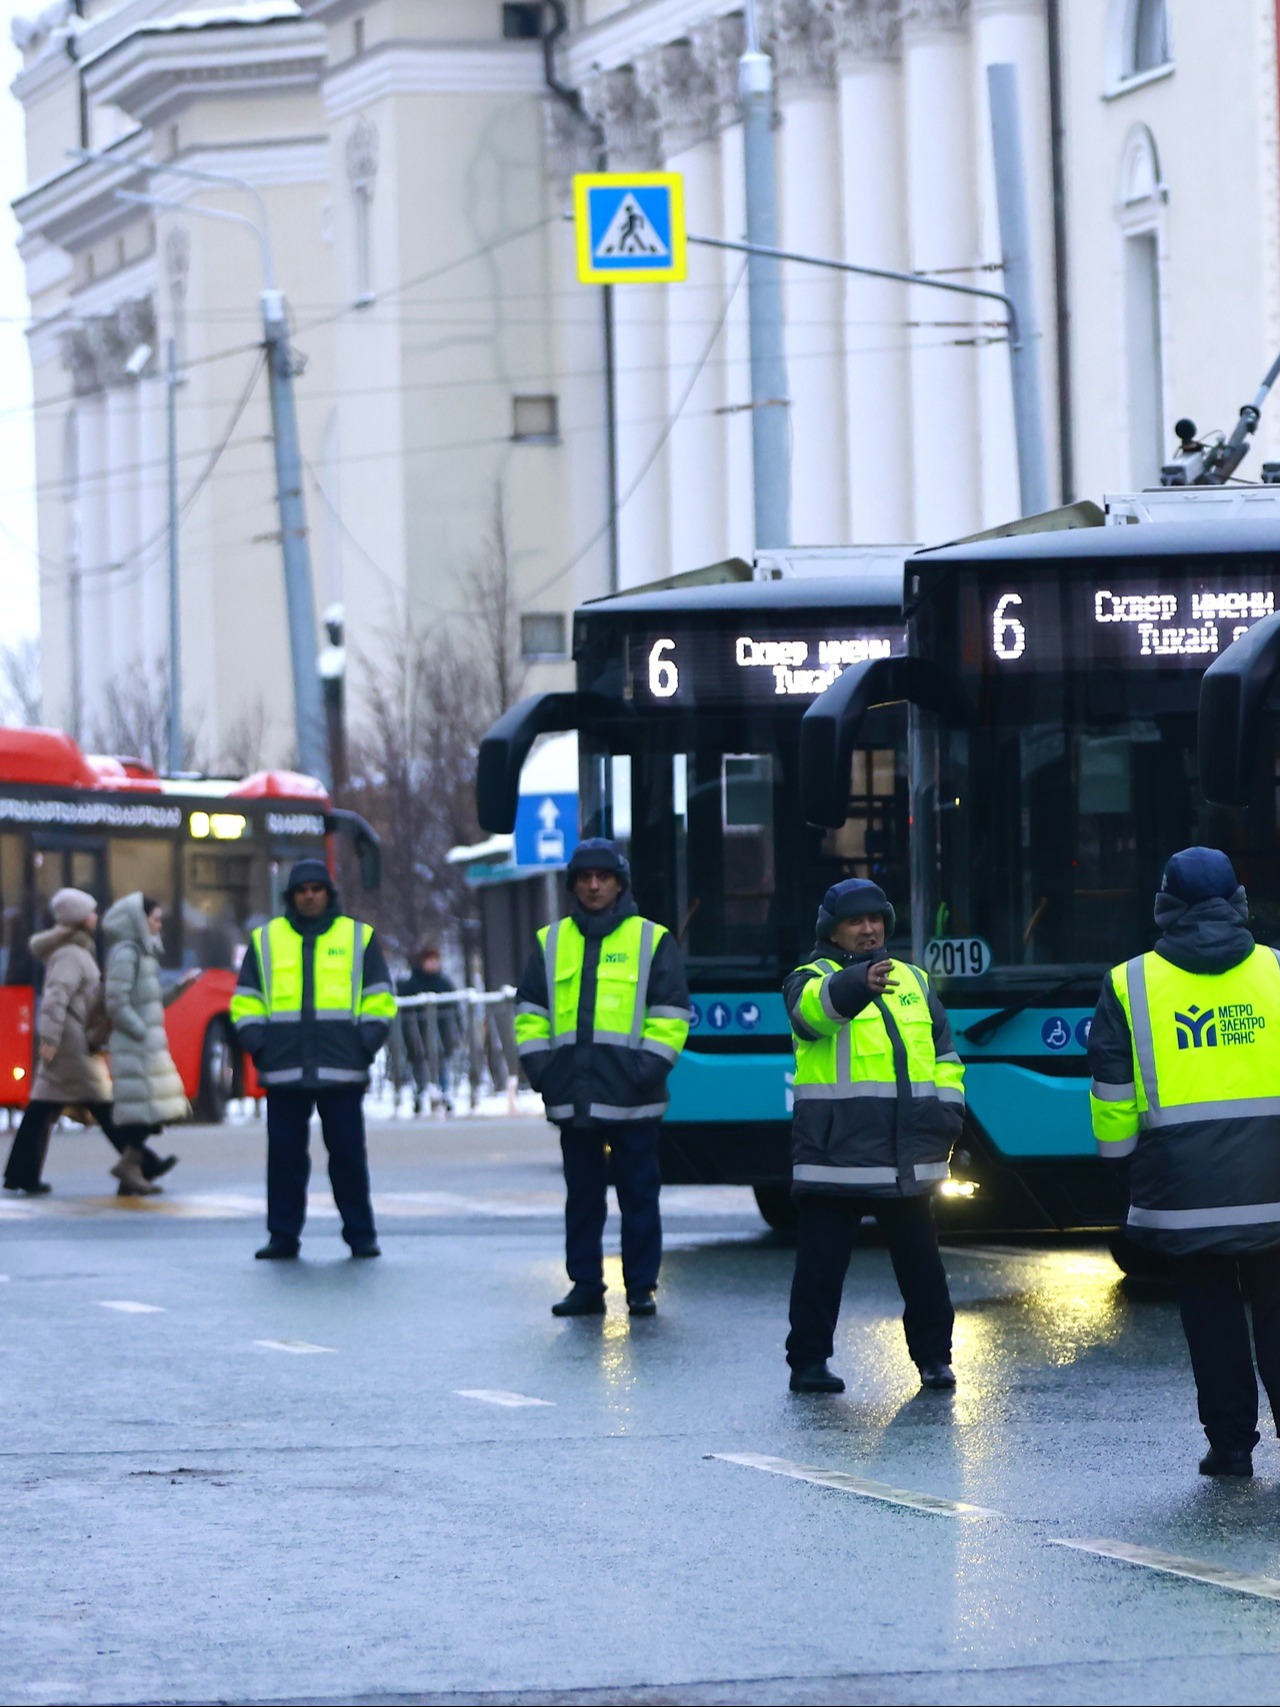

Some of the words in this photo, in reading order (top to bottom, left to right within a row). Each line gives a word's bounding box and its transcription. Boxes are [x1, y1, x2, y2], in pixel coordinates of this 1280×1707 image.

[1095, 591, 1177, 622] Сквер
[1191, 590, 1274, 620] имени
[993, 593, 1026, 659] 6
[1138, 621, 1219, 655] Тукай
[649, 638, 679, 697] 6
[929, 940, 983, 975] 2019
[1218, 1003, 1253, 1019] МЕТРО
[1220, 1016, 1266, 1032] ЭЛЕКТРО
[1221, 1031, 1256, 1046] ТРАНС
